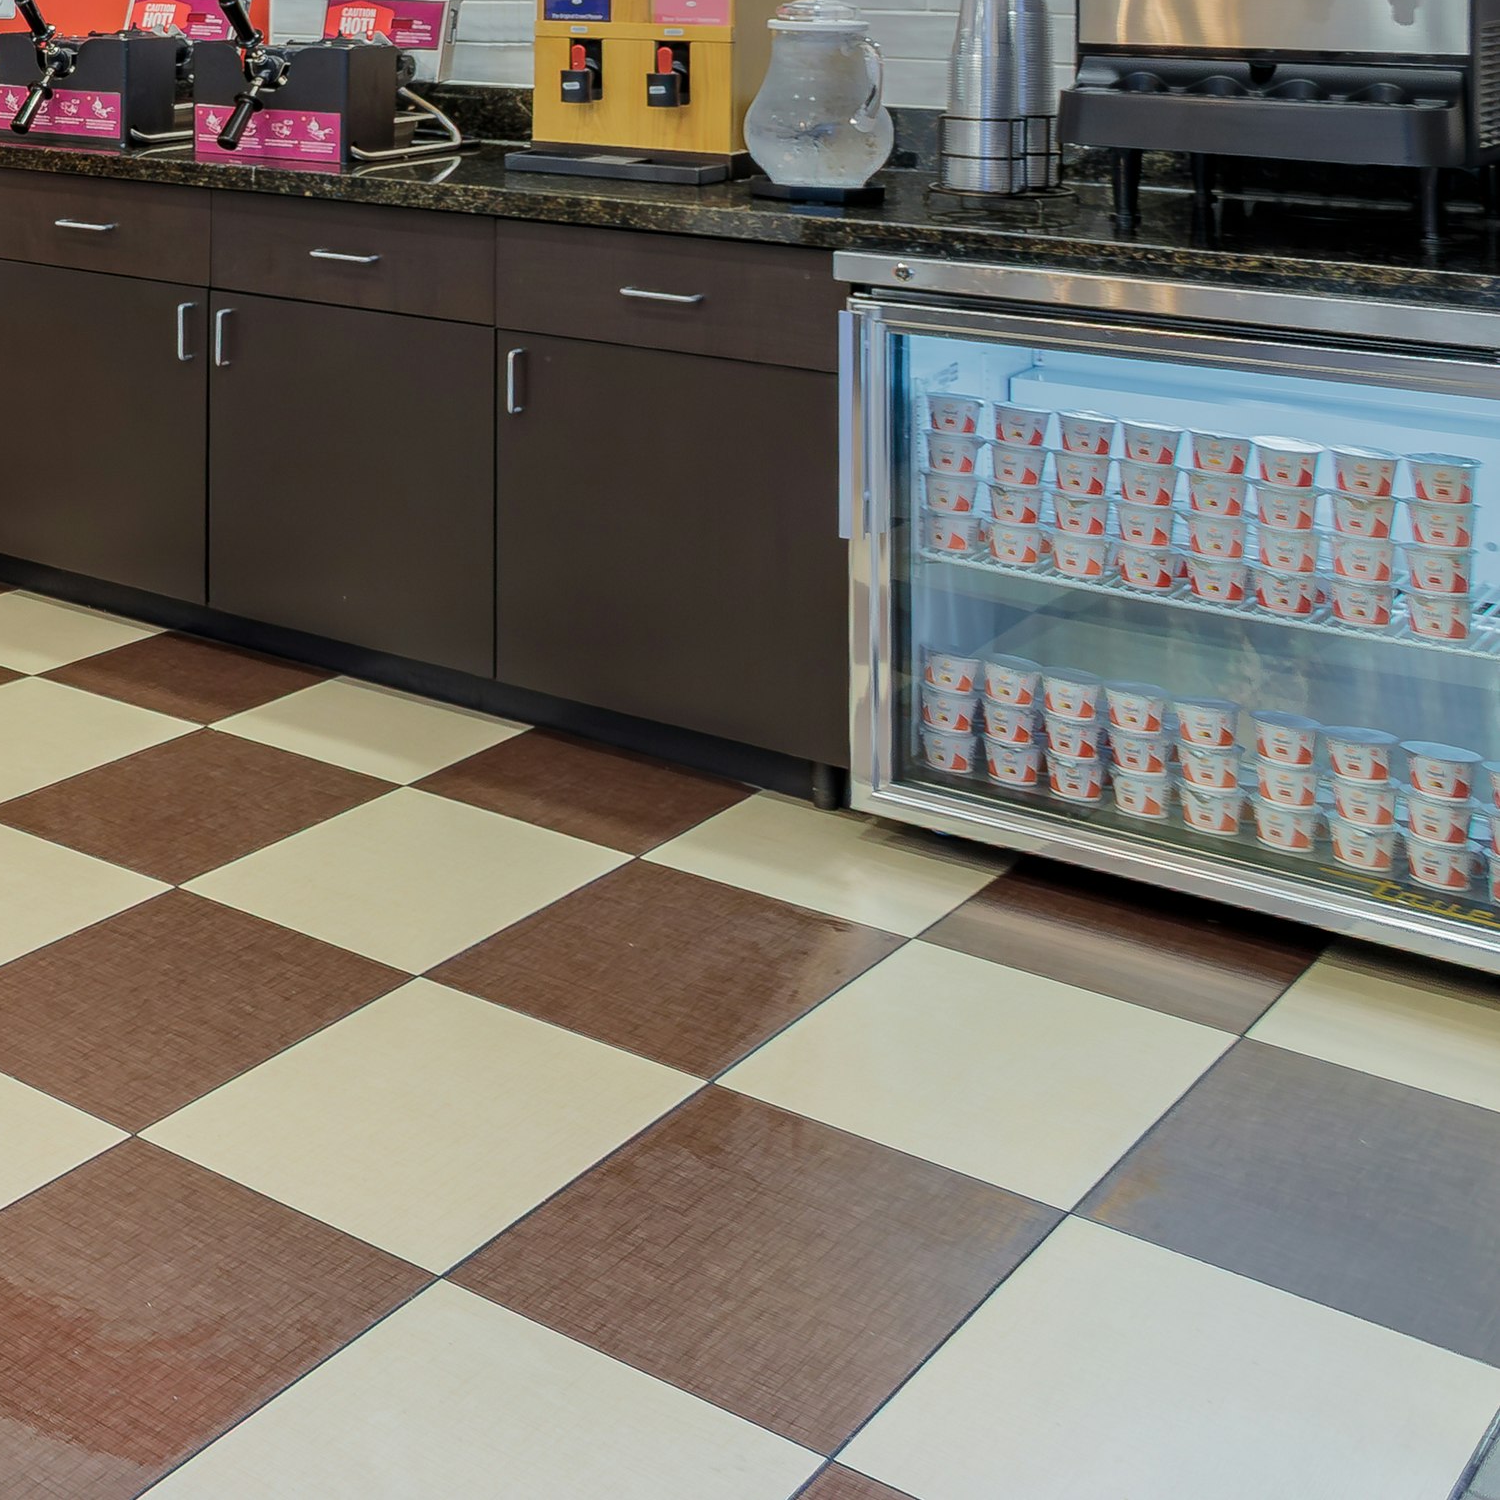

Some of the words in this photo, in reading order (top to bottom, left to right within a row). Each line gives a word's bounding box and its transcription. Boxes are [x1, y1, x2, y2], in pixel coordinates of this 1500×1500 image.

[145, 3, 176, 13] CAUTION
[341, 7, 377, 17] CAUTION
[142, 12, 175, 29] HOT!
[340, 17, 376, 35] HOT!
